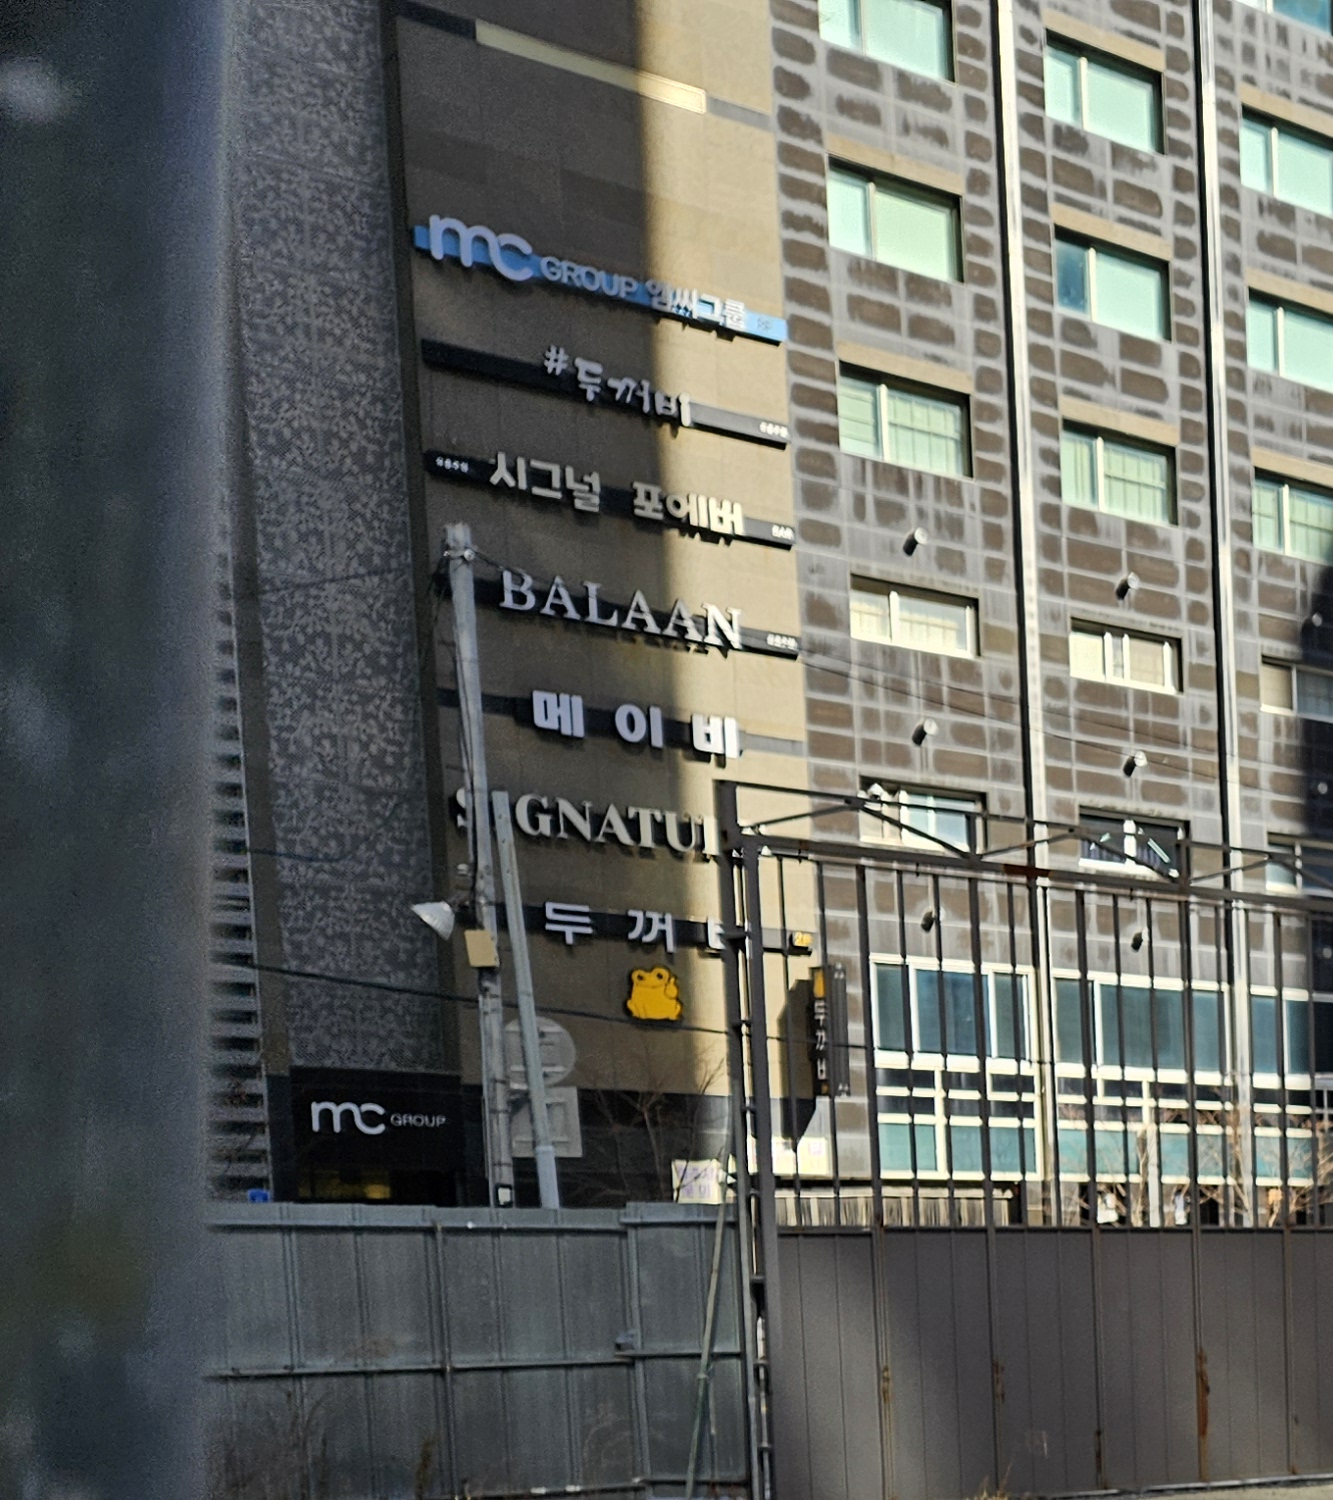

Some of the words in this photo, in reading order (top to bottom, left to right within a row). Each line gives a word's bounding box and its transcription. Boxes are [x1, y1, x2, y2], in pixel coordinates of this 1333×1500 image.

[539, 255, 639, 299] GROUP
[489, 451, 601, 512] 시그널
[632, 480, 744, 536] 포에버
[499, 568, 744, 651] BALAAN
[390, 1114, 447, 1128] GROUP
